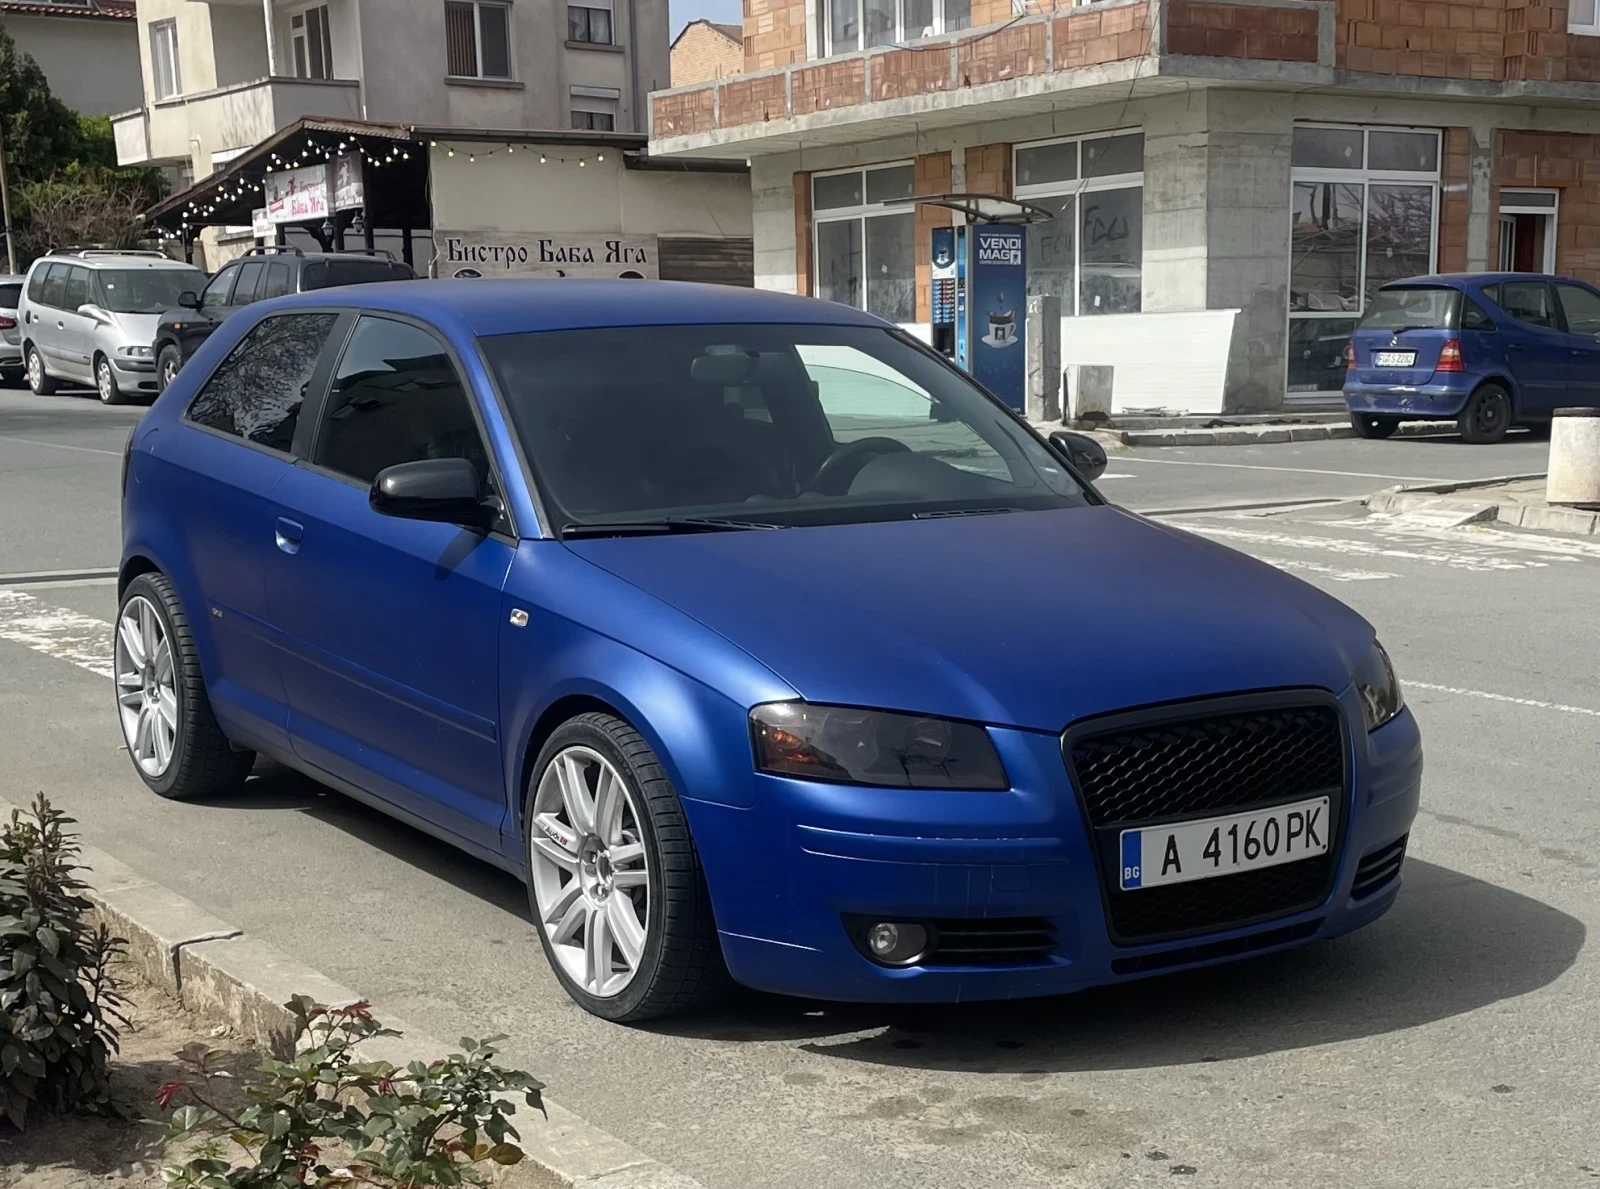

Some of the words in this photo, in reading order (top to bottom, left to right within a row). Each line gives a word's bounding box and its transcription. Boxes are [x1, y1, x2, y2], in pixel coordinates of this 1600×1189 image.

[446, 239, 528, 268] Бистро
[538, 239, 595, 263] Баба
[605, 240, 647, 263] Яга
[979, 237, 1022, 249] VENDI
[1124, 865, 1140, 880] BG
[1160, 833, 1182, 876] A
